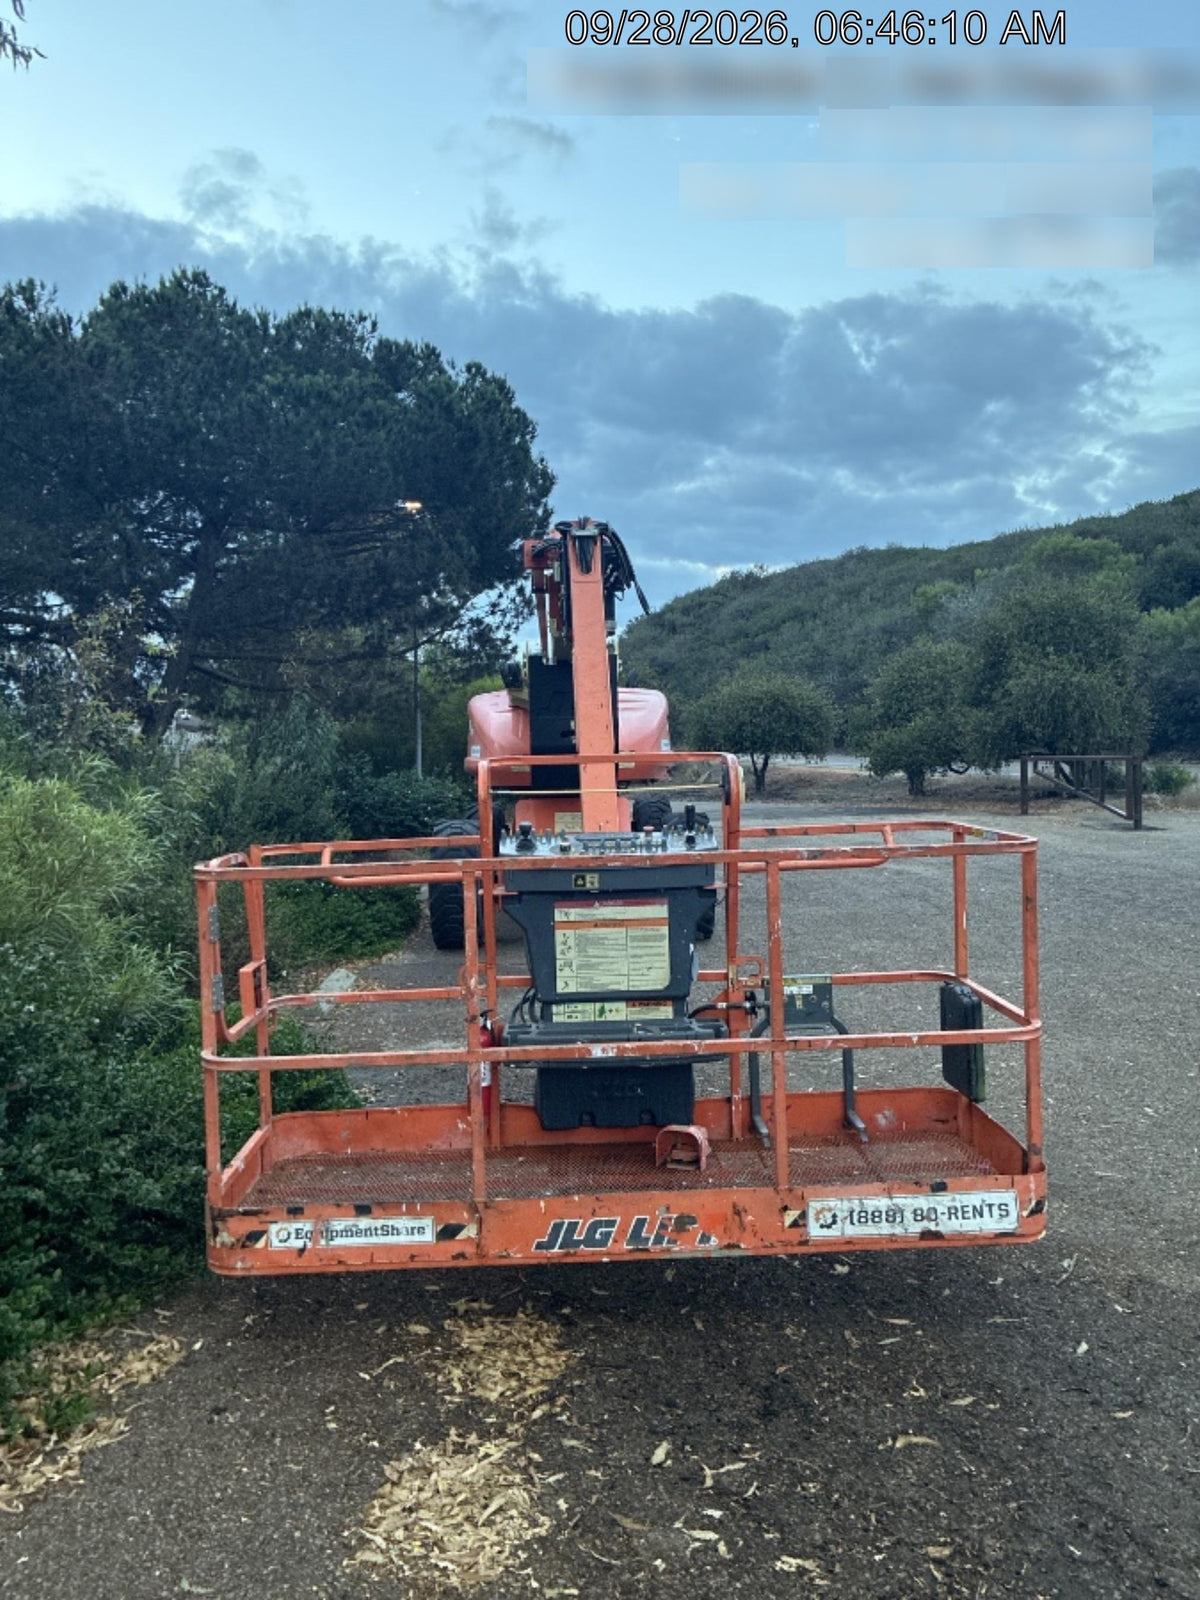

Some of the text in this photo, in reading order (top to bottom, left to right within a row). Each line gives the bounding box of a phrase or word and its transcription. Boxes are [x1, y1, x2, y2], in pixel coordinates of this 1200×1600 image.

[913, 1203, 1010, 1222] 80-RENTS
[294, 1224, 426, 1244] EqipmentShre
[531, 1214, 718, 1252] JLG LIF
